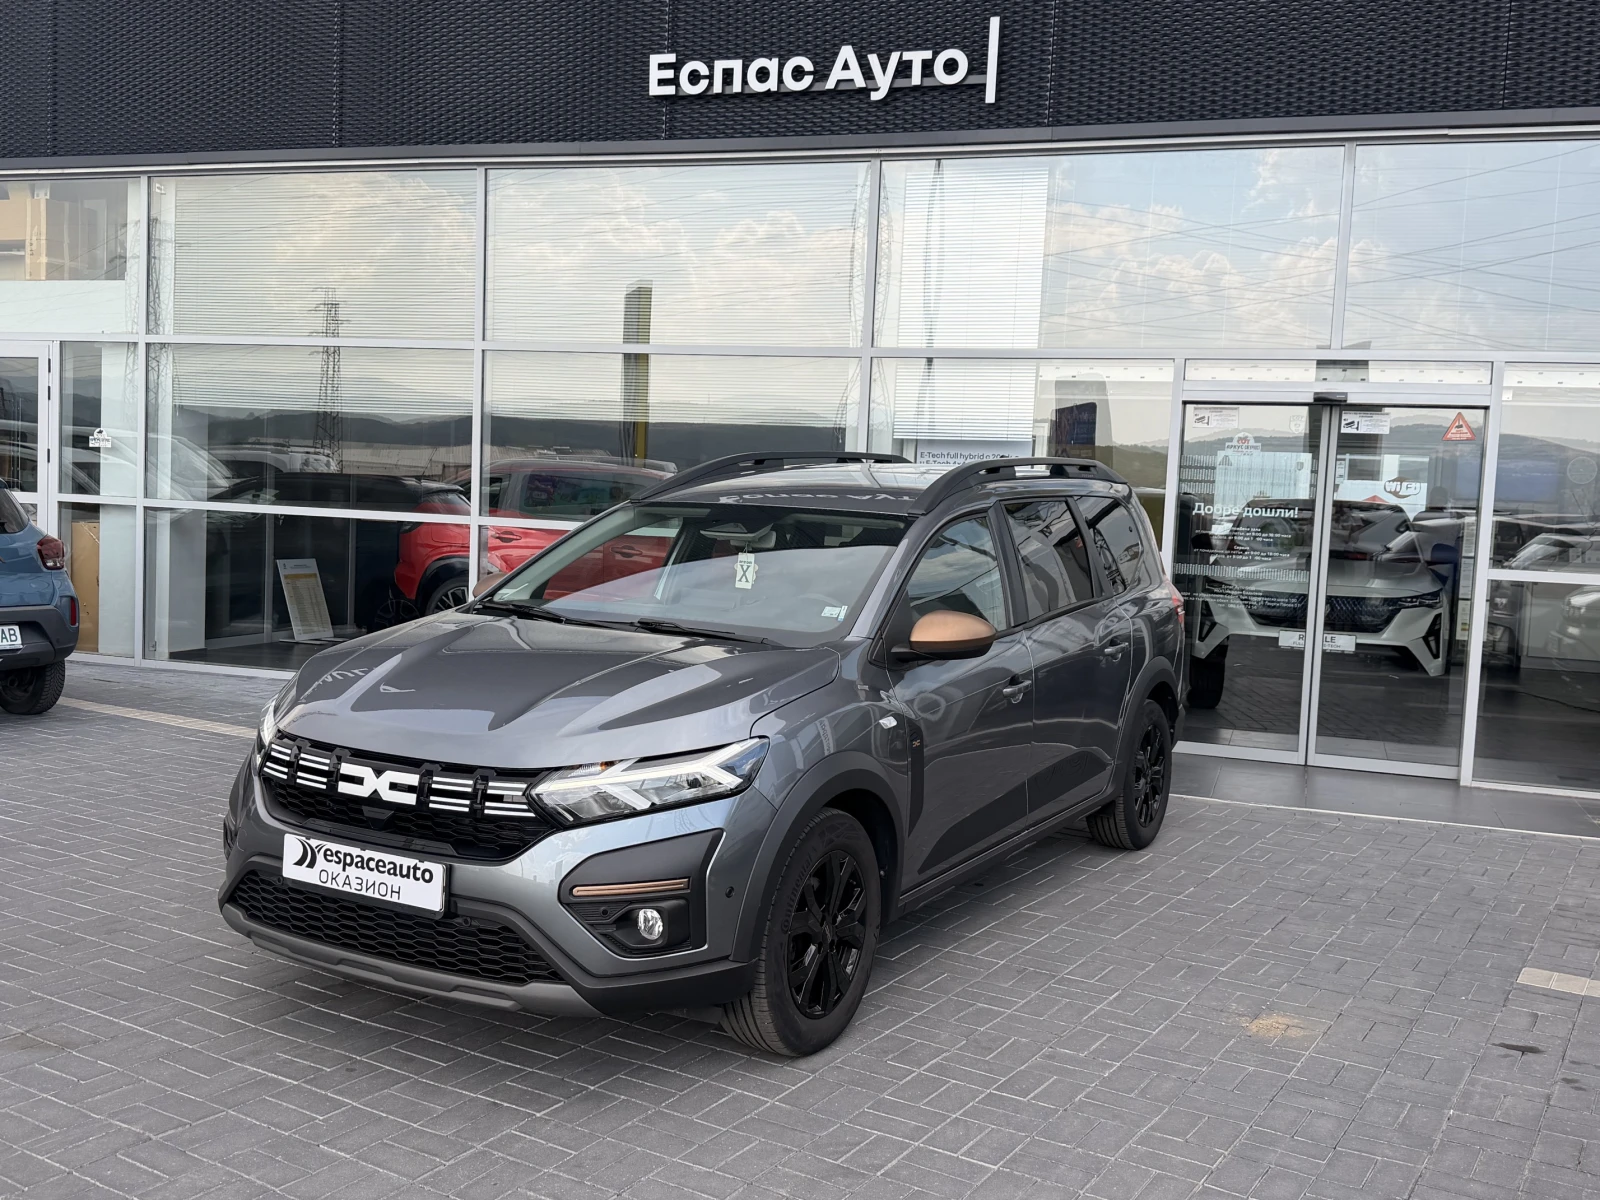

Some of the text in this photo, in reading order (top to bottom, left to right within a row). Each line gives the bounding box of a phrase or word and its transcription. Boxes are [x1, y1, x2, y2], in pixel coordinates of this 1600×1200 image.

[648, 45, 969, 101] Еспас Ауто
[920, 451, 945, 459] E-Tech
[959, 452, 984, 461] hybrid
[1192, 502, 1299, 518] Добре дошли!
[1, 628, 17, 643] AB
[323, 846, 434, 884] espaceauto
[318, 869, 402, 901] ОКАЗИОН
